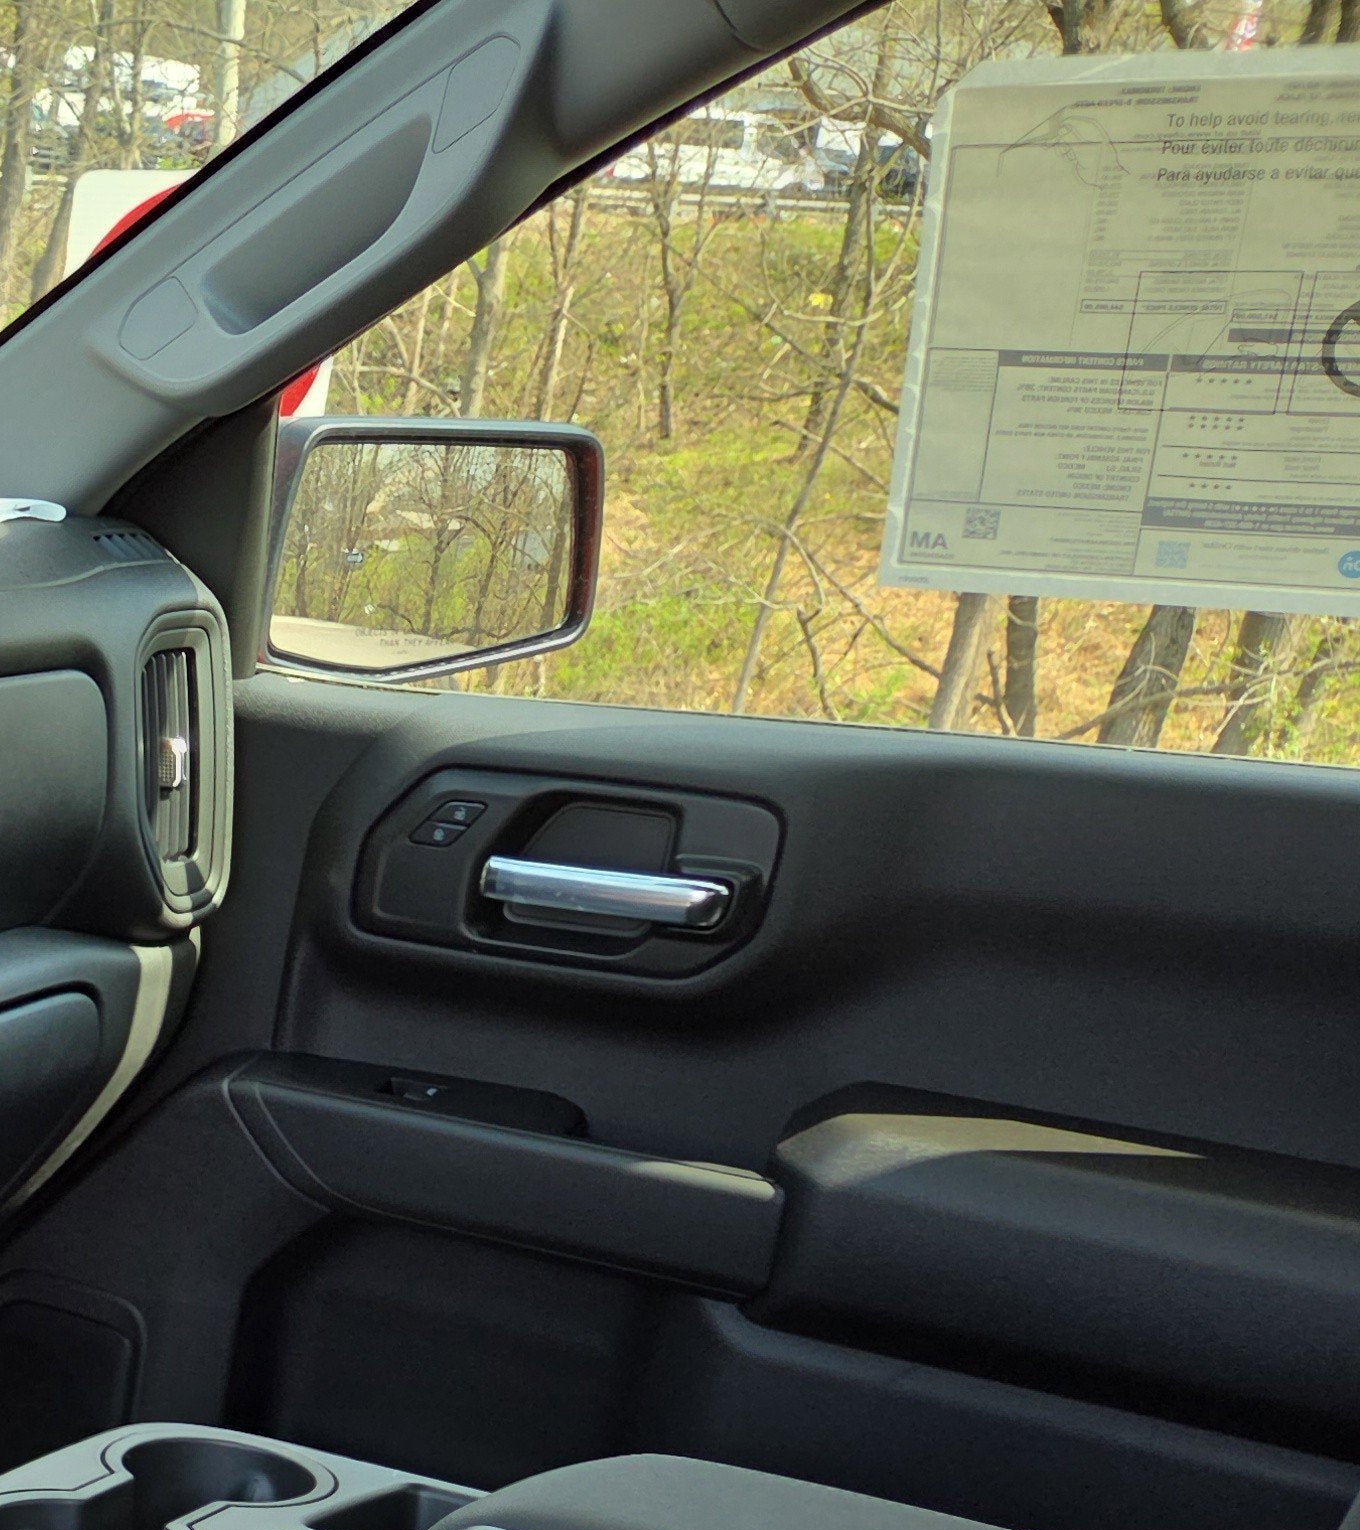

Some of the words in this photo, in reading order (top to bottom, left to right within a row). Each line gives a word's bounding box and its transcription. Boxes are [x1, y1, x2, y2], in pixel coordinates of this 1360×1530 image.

[1167, 113, 1185, 127] To
[1189, 111, 1222, 128] help
[1226, 111, 1269, 126] avoid
[1161, 140, 1197, 154] Pour
[1248, 138, 1289, 153] toute
[1156, 167, 1191, 182] Para
[1195, 165, 1266, 185] ayudarse
[1269, 168, 1281, 180] a
[1284, 165, 1330, 180] evitar
